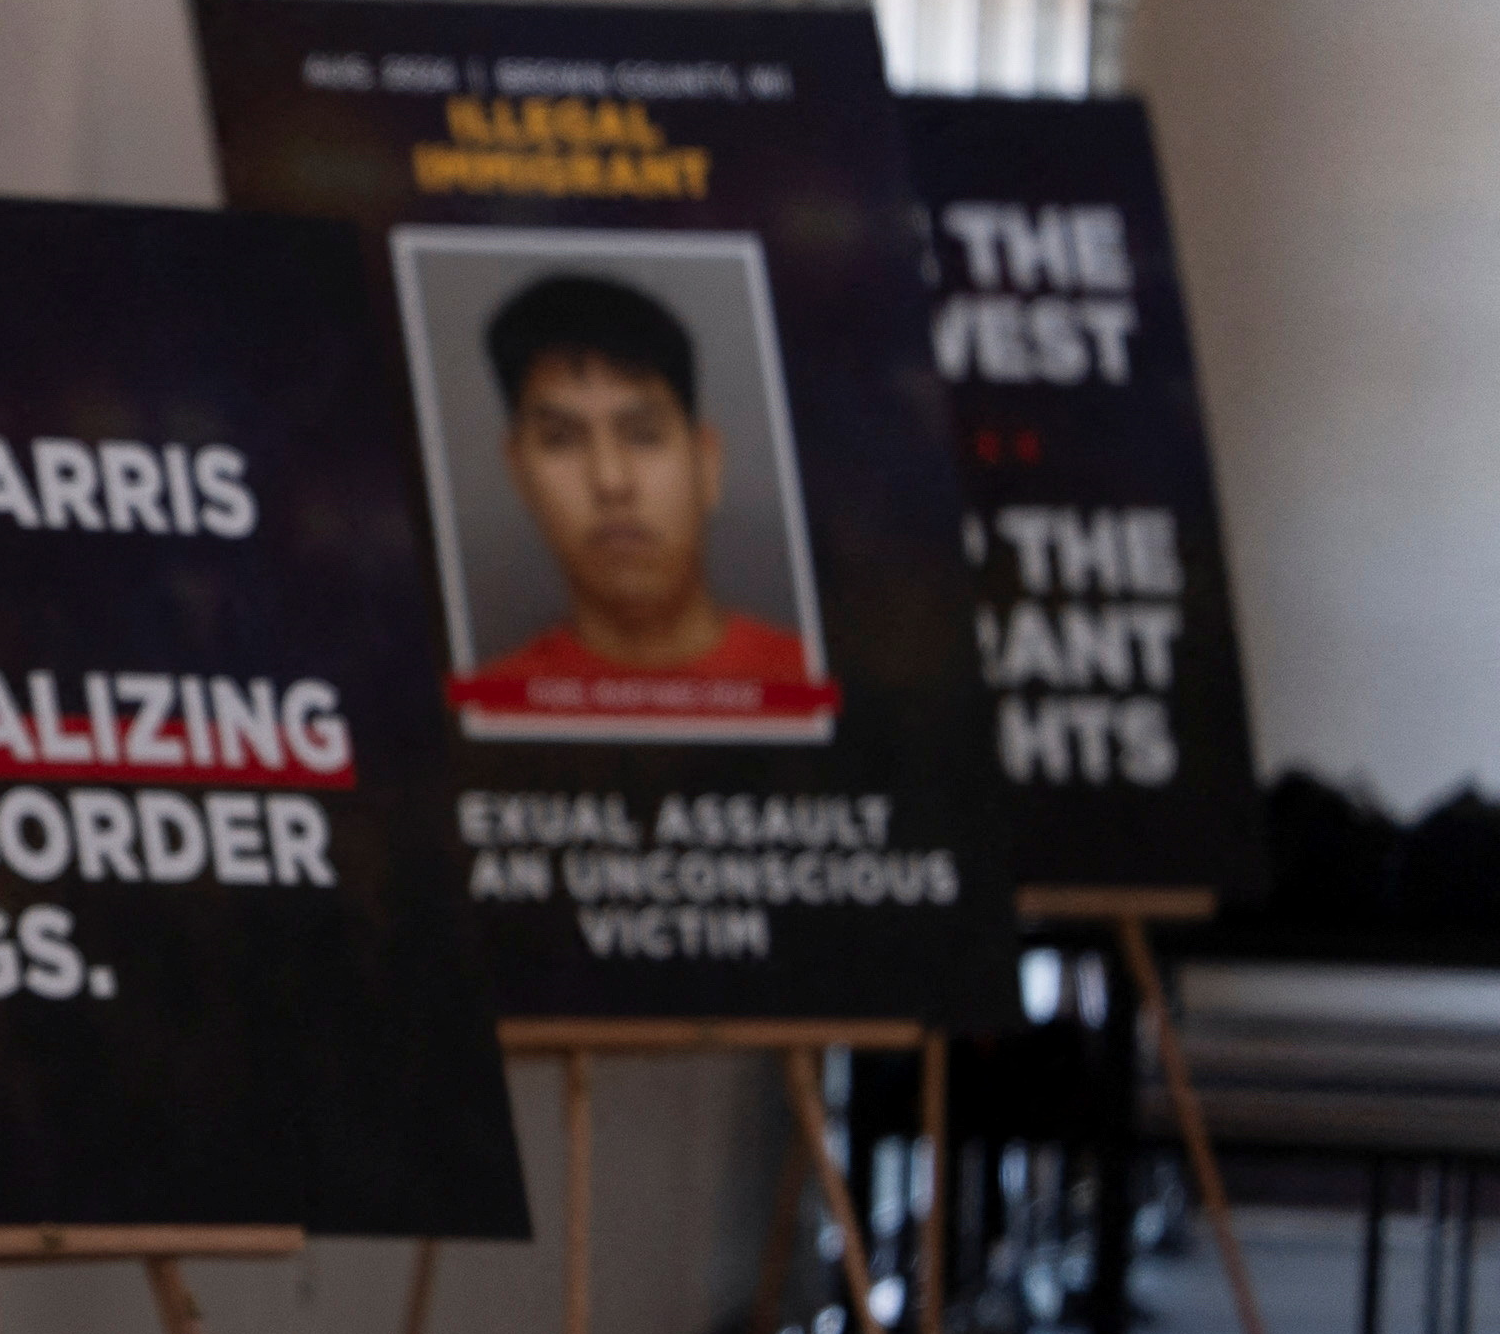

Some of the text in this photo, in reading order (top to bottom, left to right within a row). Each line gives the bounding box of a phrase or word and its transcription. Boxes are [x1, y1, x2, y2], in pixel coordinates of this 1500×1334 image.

[654, 789, 892, 847] ASSAULT
[562, 849, 960, 905] UNCONSCIOUS
[577, 905, 770, 959] VICTIM
